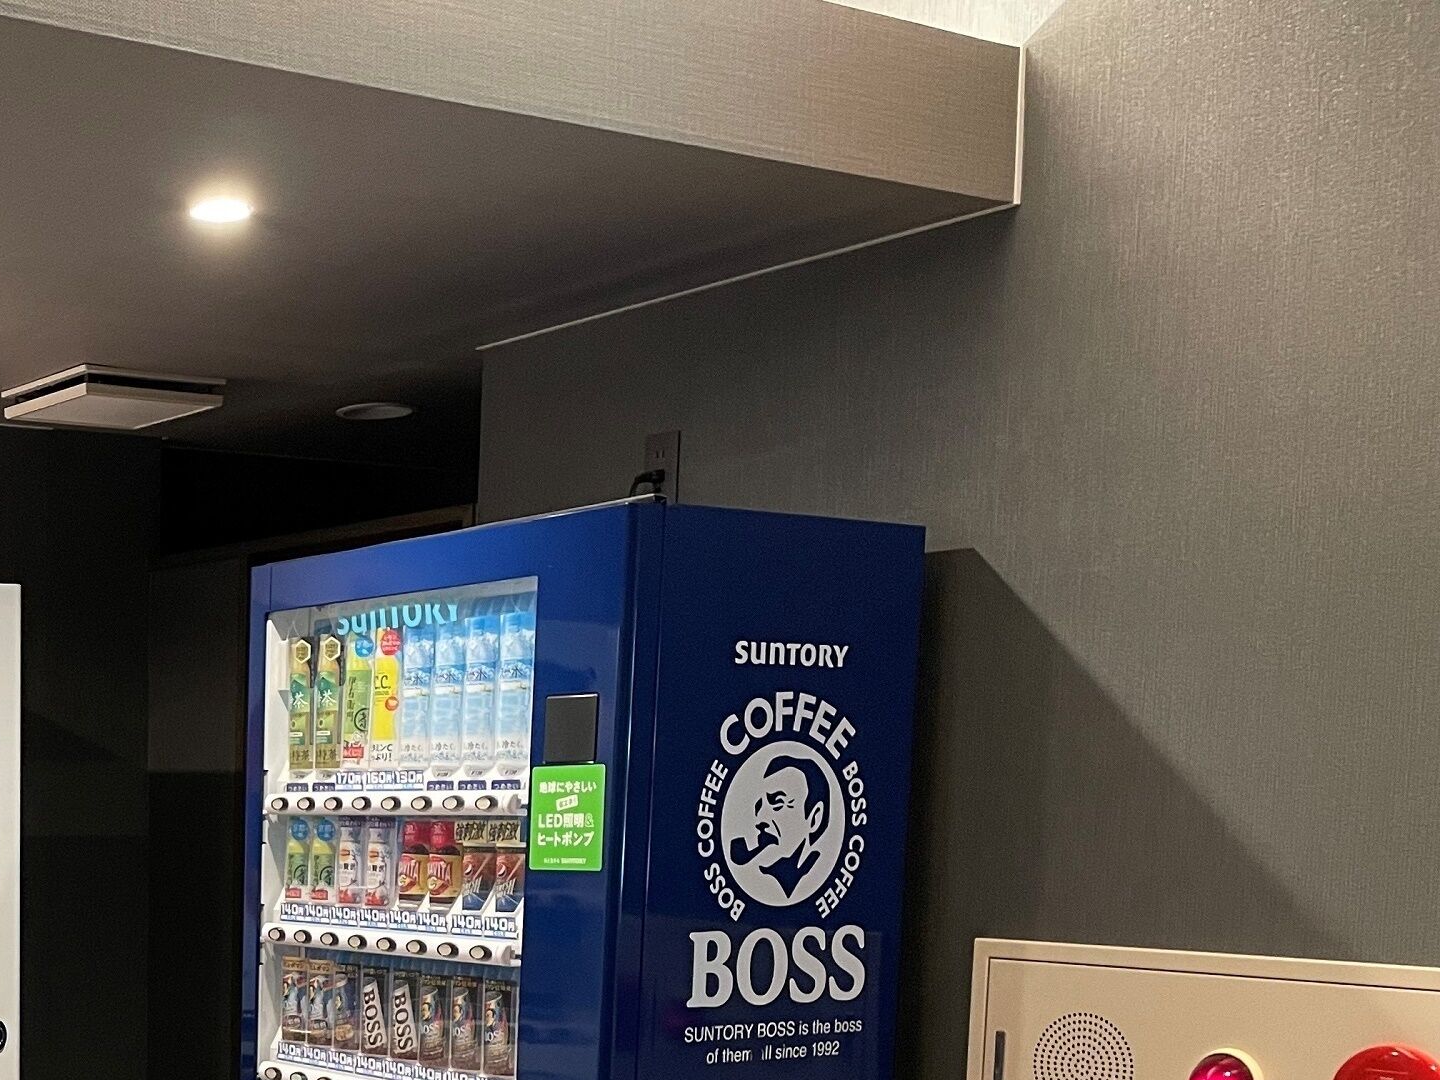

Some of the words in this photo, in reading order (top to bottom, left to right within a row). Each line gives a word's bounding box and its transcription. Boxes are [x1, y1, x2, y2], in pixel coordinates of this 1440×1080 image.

[735, 640, 849, 669] SUNTORY
[720, 691, 856, 761] COFFEE
[336, 772, 361, 785] 170円
[367, 772, 393, 785] 160円
[539, 781, 597, 794] 地球にやさしい
[842, 761, 867, 826] BOSS
[697, 760, 729, 858] COFFEE
[537, 831, 595, 847] ヒートポンプ
[703, 862, 746, 922] BOSS
[816, 833, 865, 919] COFFEE
[686, 925, 866, 1008] BOSS
[363, 988, 383, 1046] BOSS
[394, 993, 414, 1050] BOSS
[684, 1024, 754, 1043] SUNTORY
[757, 1021, 796, 1038] BOSS
[798, 1020, 809, 1036] is
[812, 1019, 831, 1035] the
[834, 1018, 862, 1033] boss
[706, 1048, 719, 1065] of
[722, 1048, 752, 1064] them
[775, 1044, 807, 1060] since
[812, 1040, 840, 1057] 1992
